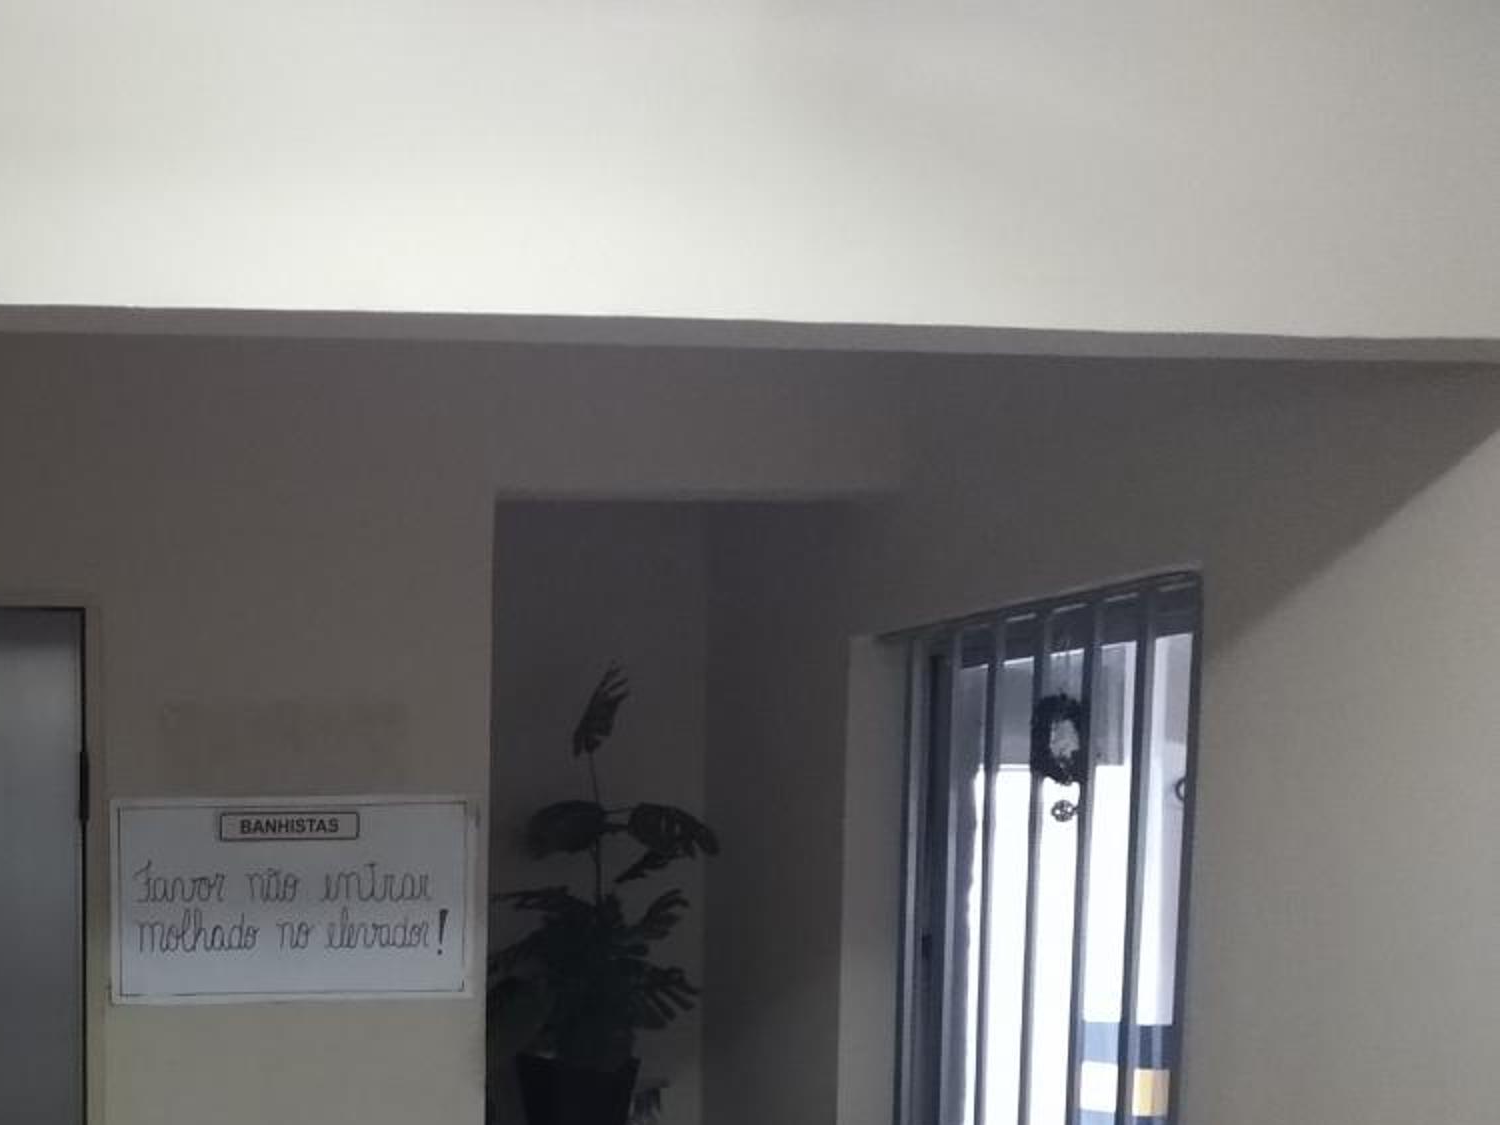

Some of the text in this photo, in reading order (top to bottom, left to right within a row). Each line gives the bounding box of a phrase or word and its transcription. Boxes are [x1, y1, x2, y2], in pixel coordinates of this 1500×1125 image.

[239, 818, 340, 834] BANHISTAS
[244, 866, 301, 903] não
[322, 861, 431, 902] entrar
[275, 920, 313, 950] no
